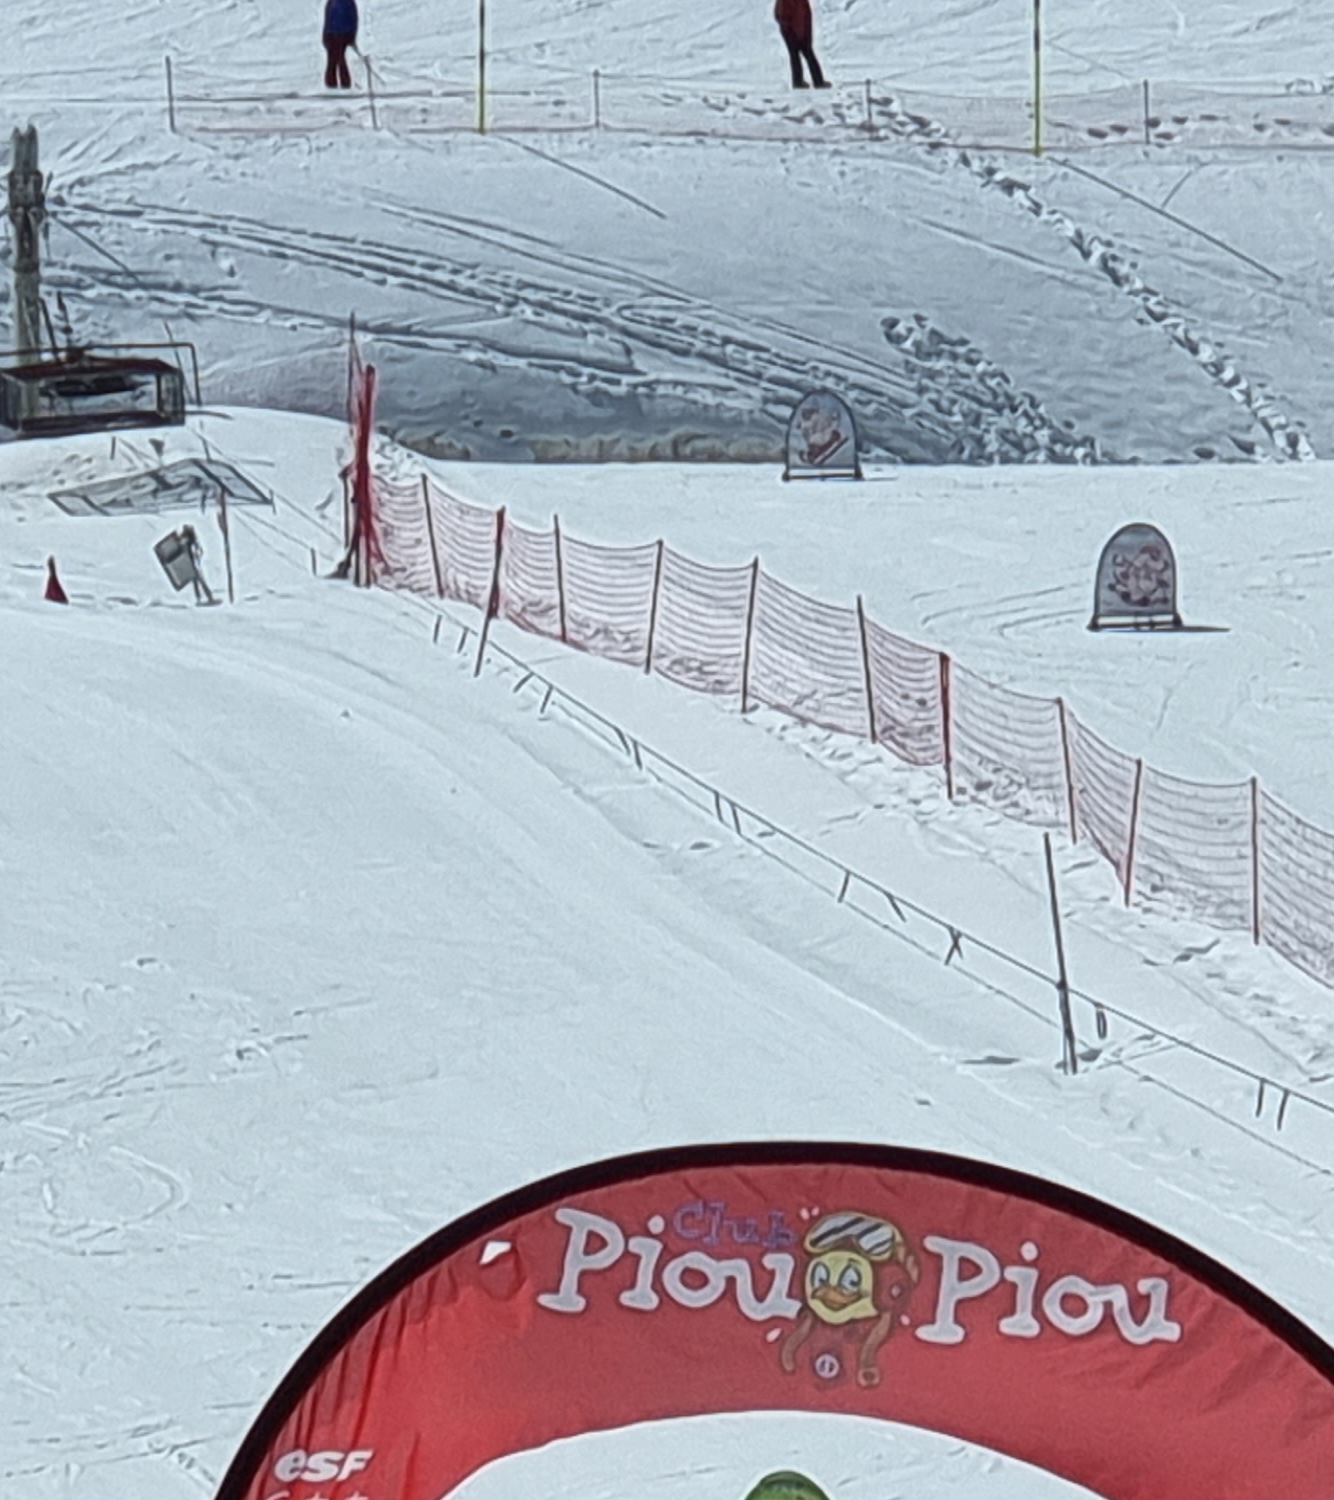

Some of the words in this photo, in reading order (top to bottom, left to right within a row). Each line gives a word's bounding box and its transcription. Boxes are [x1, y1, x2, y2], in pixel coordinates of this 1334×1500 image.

[673, 1201, 798, 1248] Club
[537, 1208, 802, 1321] Piou
[915, 1236, 1181, 1344] Piou
